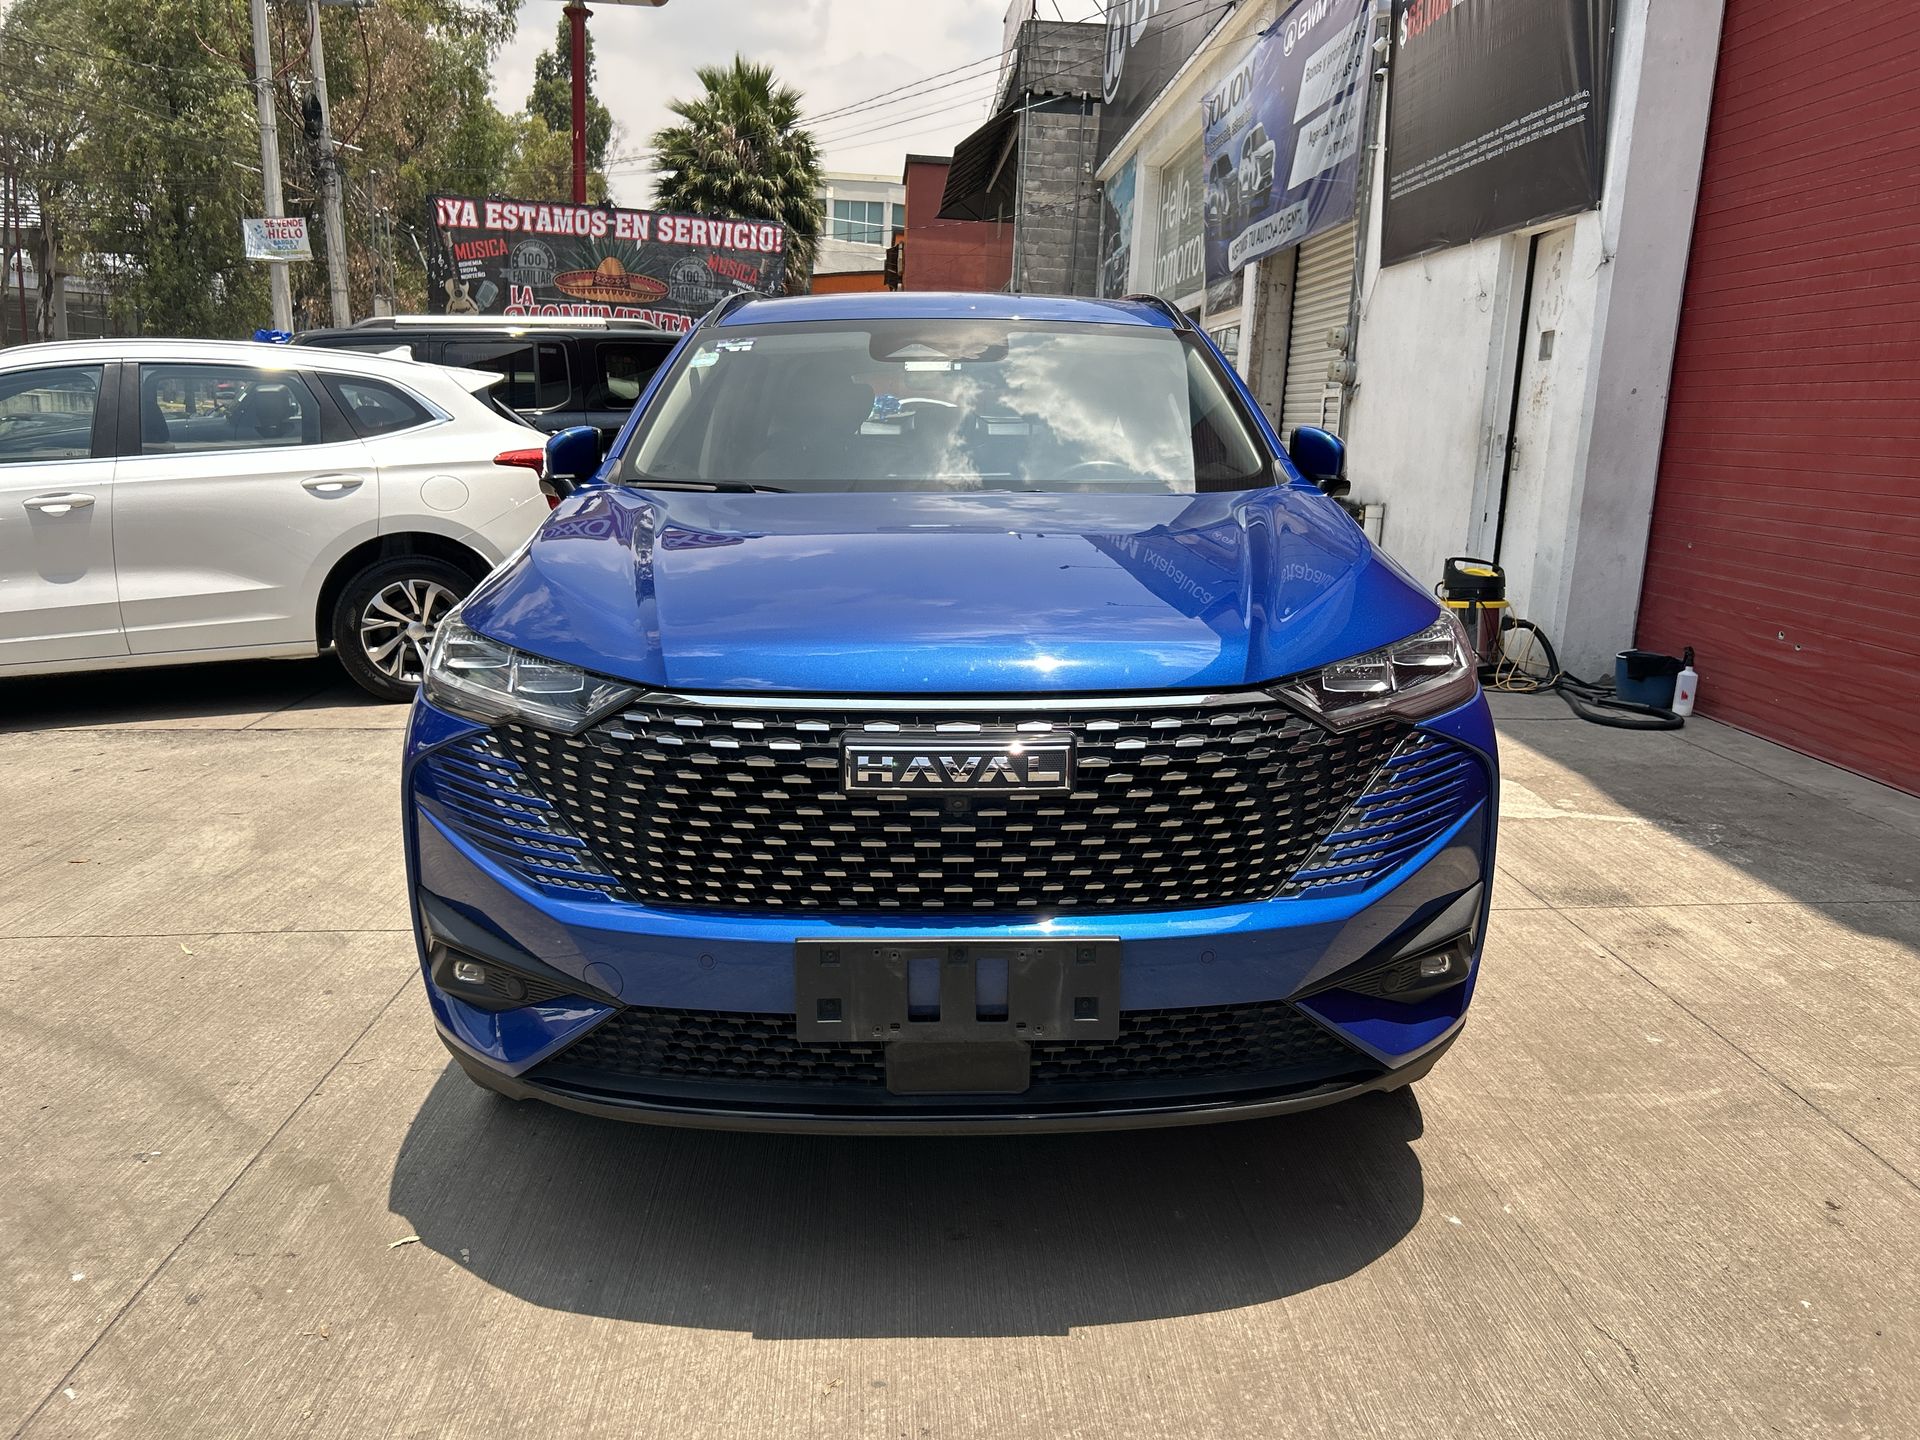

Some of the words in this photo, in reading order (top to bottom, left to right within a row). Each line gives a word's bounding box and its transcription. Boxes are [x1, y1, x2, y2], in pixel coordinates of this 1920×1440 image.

[1297, 0, 1327, 40] GWM
[1206, 60, 1257, 133] JOLION
[1160, 168, 1192, 233] Hello,
[264, 220, 275, 228] SE
[277, 219, 304, 227] VENDE
[268, 228, 303, 239] HIELO
[485, 202, 609, 238] ESTAMOS
[614, 212, 650, 241] EN
[657, 215, 784, 253] SERVICIO!
[454, 238, 509, 261] MUSICA
[458, 260, 483, 268] BOHEMIA
[707, 254, 760, 285] MUSICA
[512, 269, 552, 285] FAMILIAR
[509, 285, 536, 306] LA
[671, 285, 709, 302] FAMILIAR
[503, 303, 699, 333] MONUMENTA
[857, 755, 1060, 783] HAVAL
